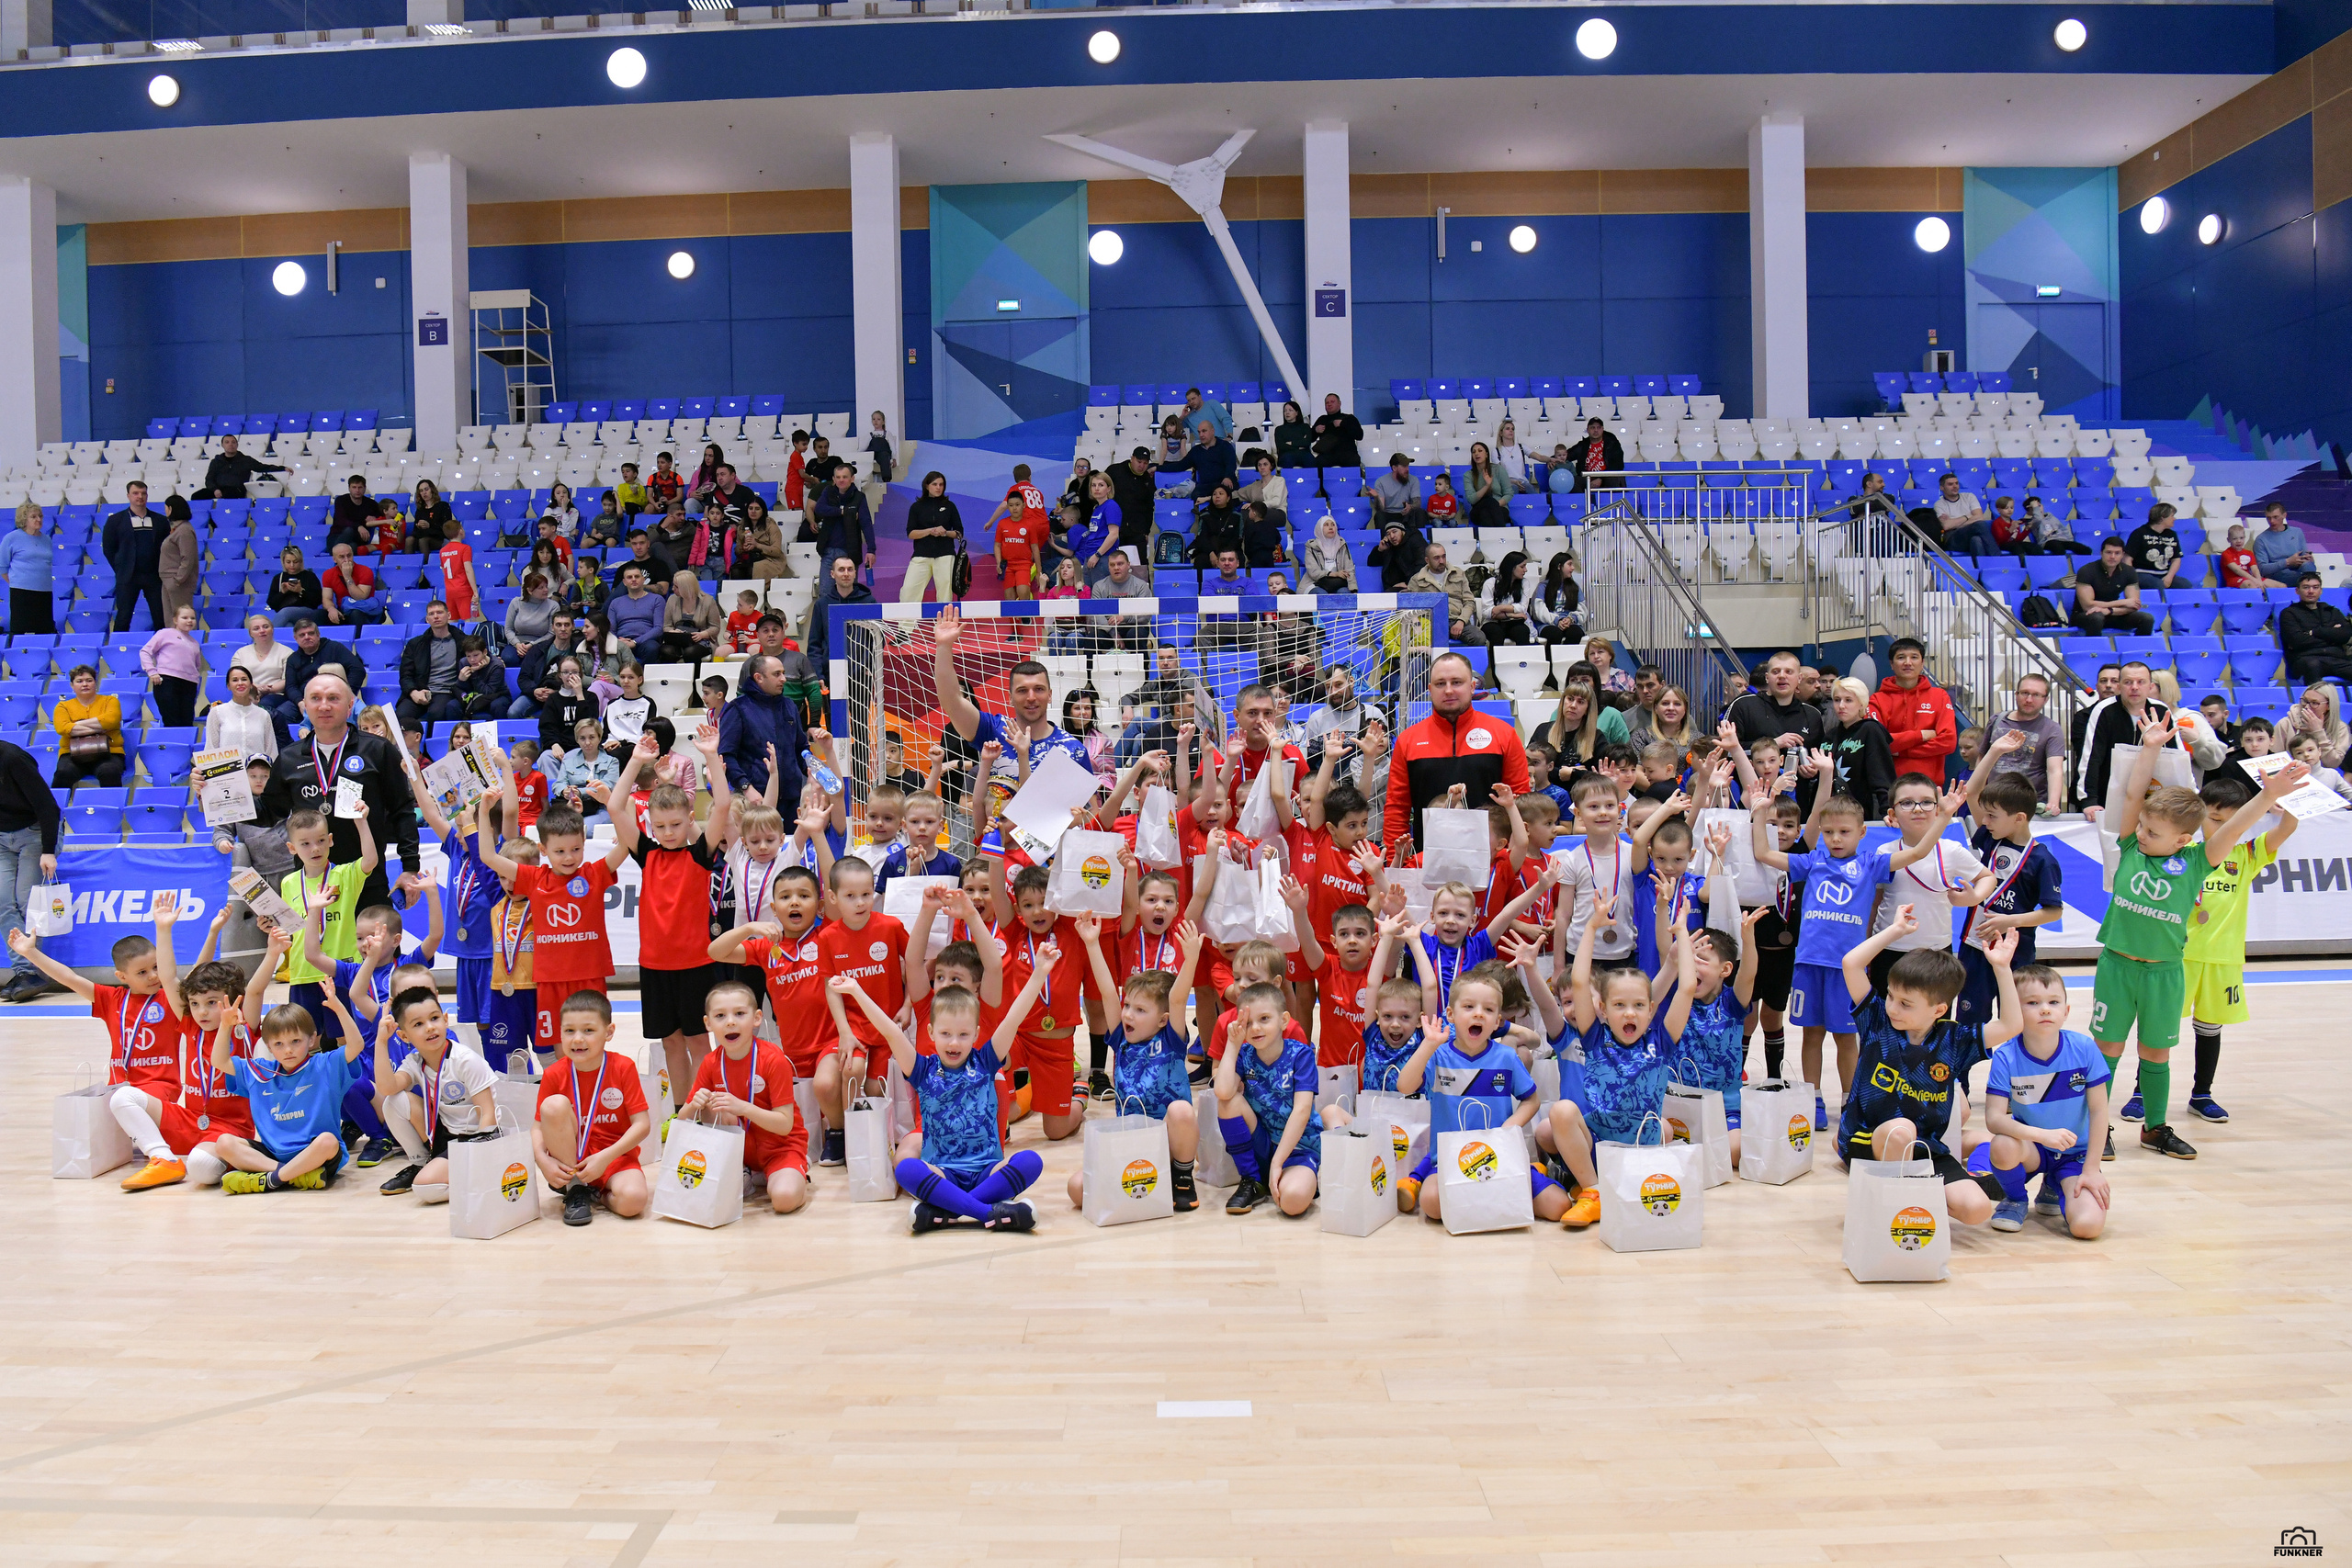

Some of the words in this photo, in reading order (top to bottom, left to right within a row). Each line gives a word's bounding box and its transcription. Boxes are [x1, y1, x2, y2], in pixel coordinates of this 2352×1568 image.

[1024, 489, 1044, 509] 88
[444, 558, 453, 580] 1
[563, 705, 577, 722] NY
[197, 750, 239, 765] ДИПЛОМ
[475, 739, 499, 787] ГРАМОТА
[2244, 756, 2290, 771] ГРАМОТА
[223, 789, 232, 799] 2
[1085, 862, 1110, 870] ТУРНИР
[232, 871, 259, 890] ГРАМОТА
[2251, 857, 2352, 894] РНИ
[537, 931, 599, 944] НОРНИКЕЛЬ
[775, 964, 819, 986] АРКТИКА
[841, 964, 886, 980] АРКТИКА
[2224, 984, 2240, 1006] 10
[2093, 998, 2108, 1032] 2
[538, 1010, 554, 1039] 3
[1149, 1039, 1162, 1057] 19
[110, 1055, 174, 1068] НОИКЕЛЬ
[275, 1109, 306, 1122] ГАЗПРОМ
[581, 1112, 619, 1126] КИКА
[1790, 1121, 1808, 1133] ТУРНИР
[684, 1155, 706, 1168] ТУРНИР
[1461, 1145, 1487, 1165] ТУРНИР
[504, 1169, 526, 1181] ТУРНИР
[1126, 1167, 1154, 1179] ТУРНИР
[1645, 1181, 1676, 1193] ТУРНИР
[1897, 1214, 1933, 1229] ТУРНИР
